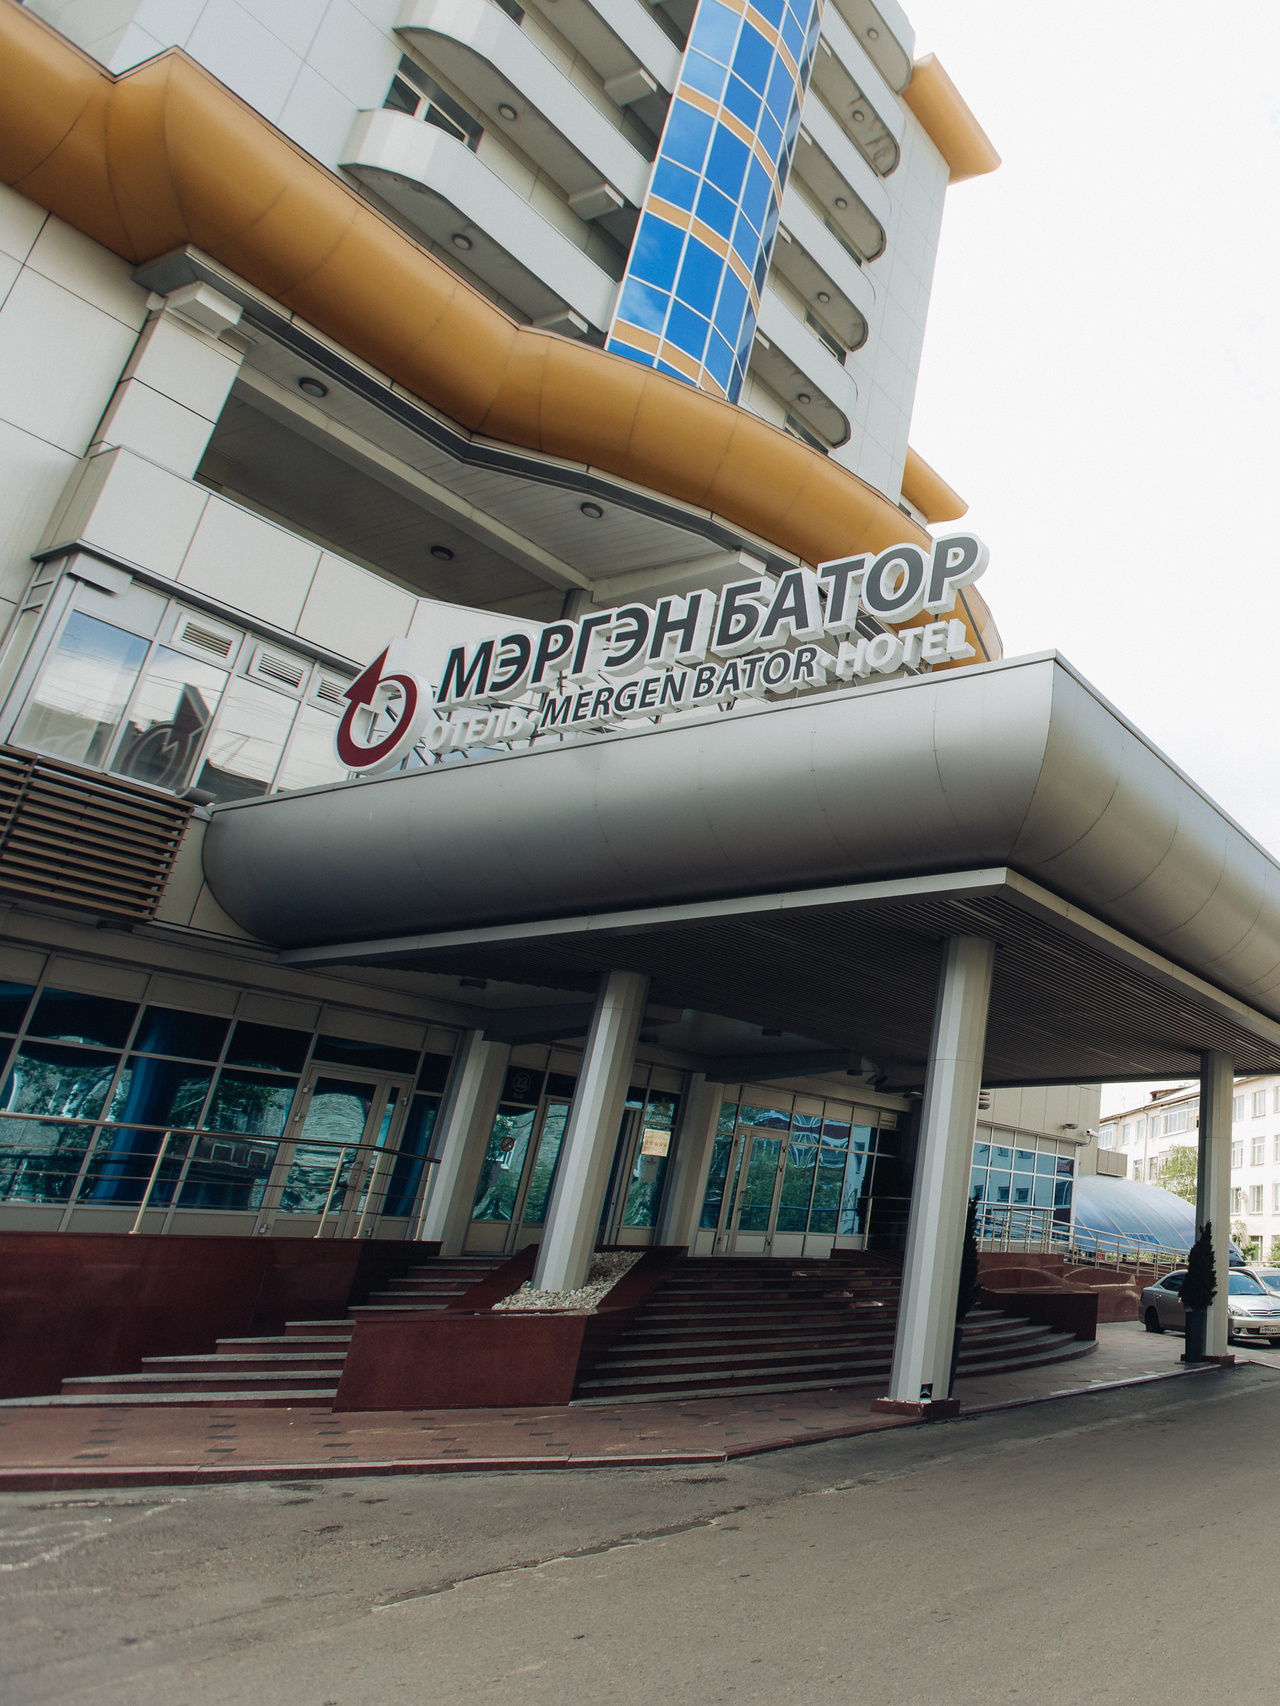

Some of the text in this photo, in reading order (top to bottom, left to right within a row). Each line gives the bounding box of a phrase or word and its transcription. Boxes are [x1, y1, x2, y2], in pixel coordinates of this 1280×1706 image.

[435, 534, 984, 706] МЭРГЭН БАТОР
[540, 619, 975, 732] MERGEN BATOR HOTEL
[427, 706, 534, 752] ОТЕЛЬ
